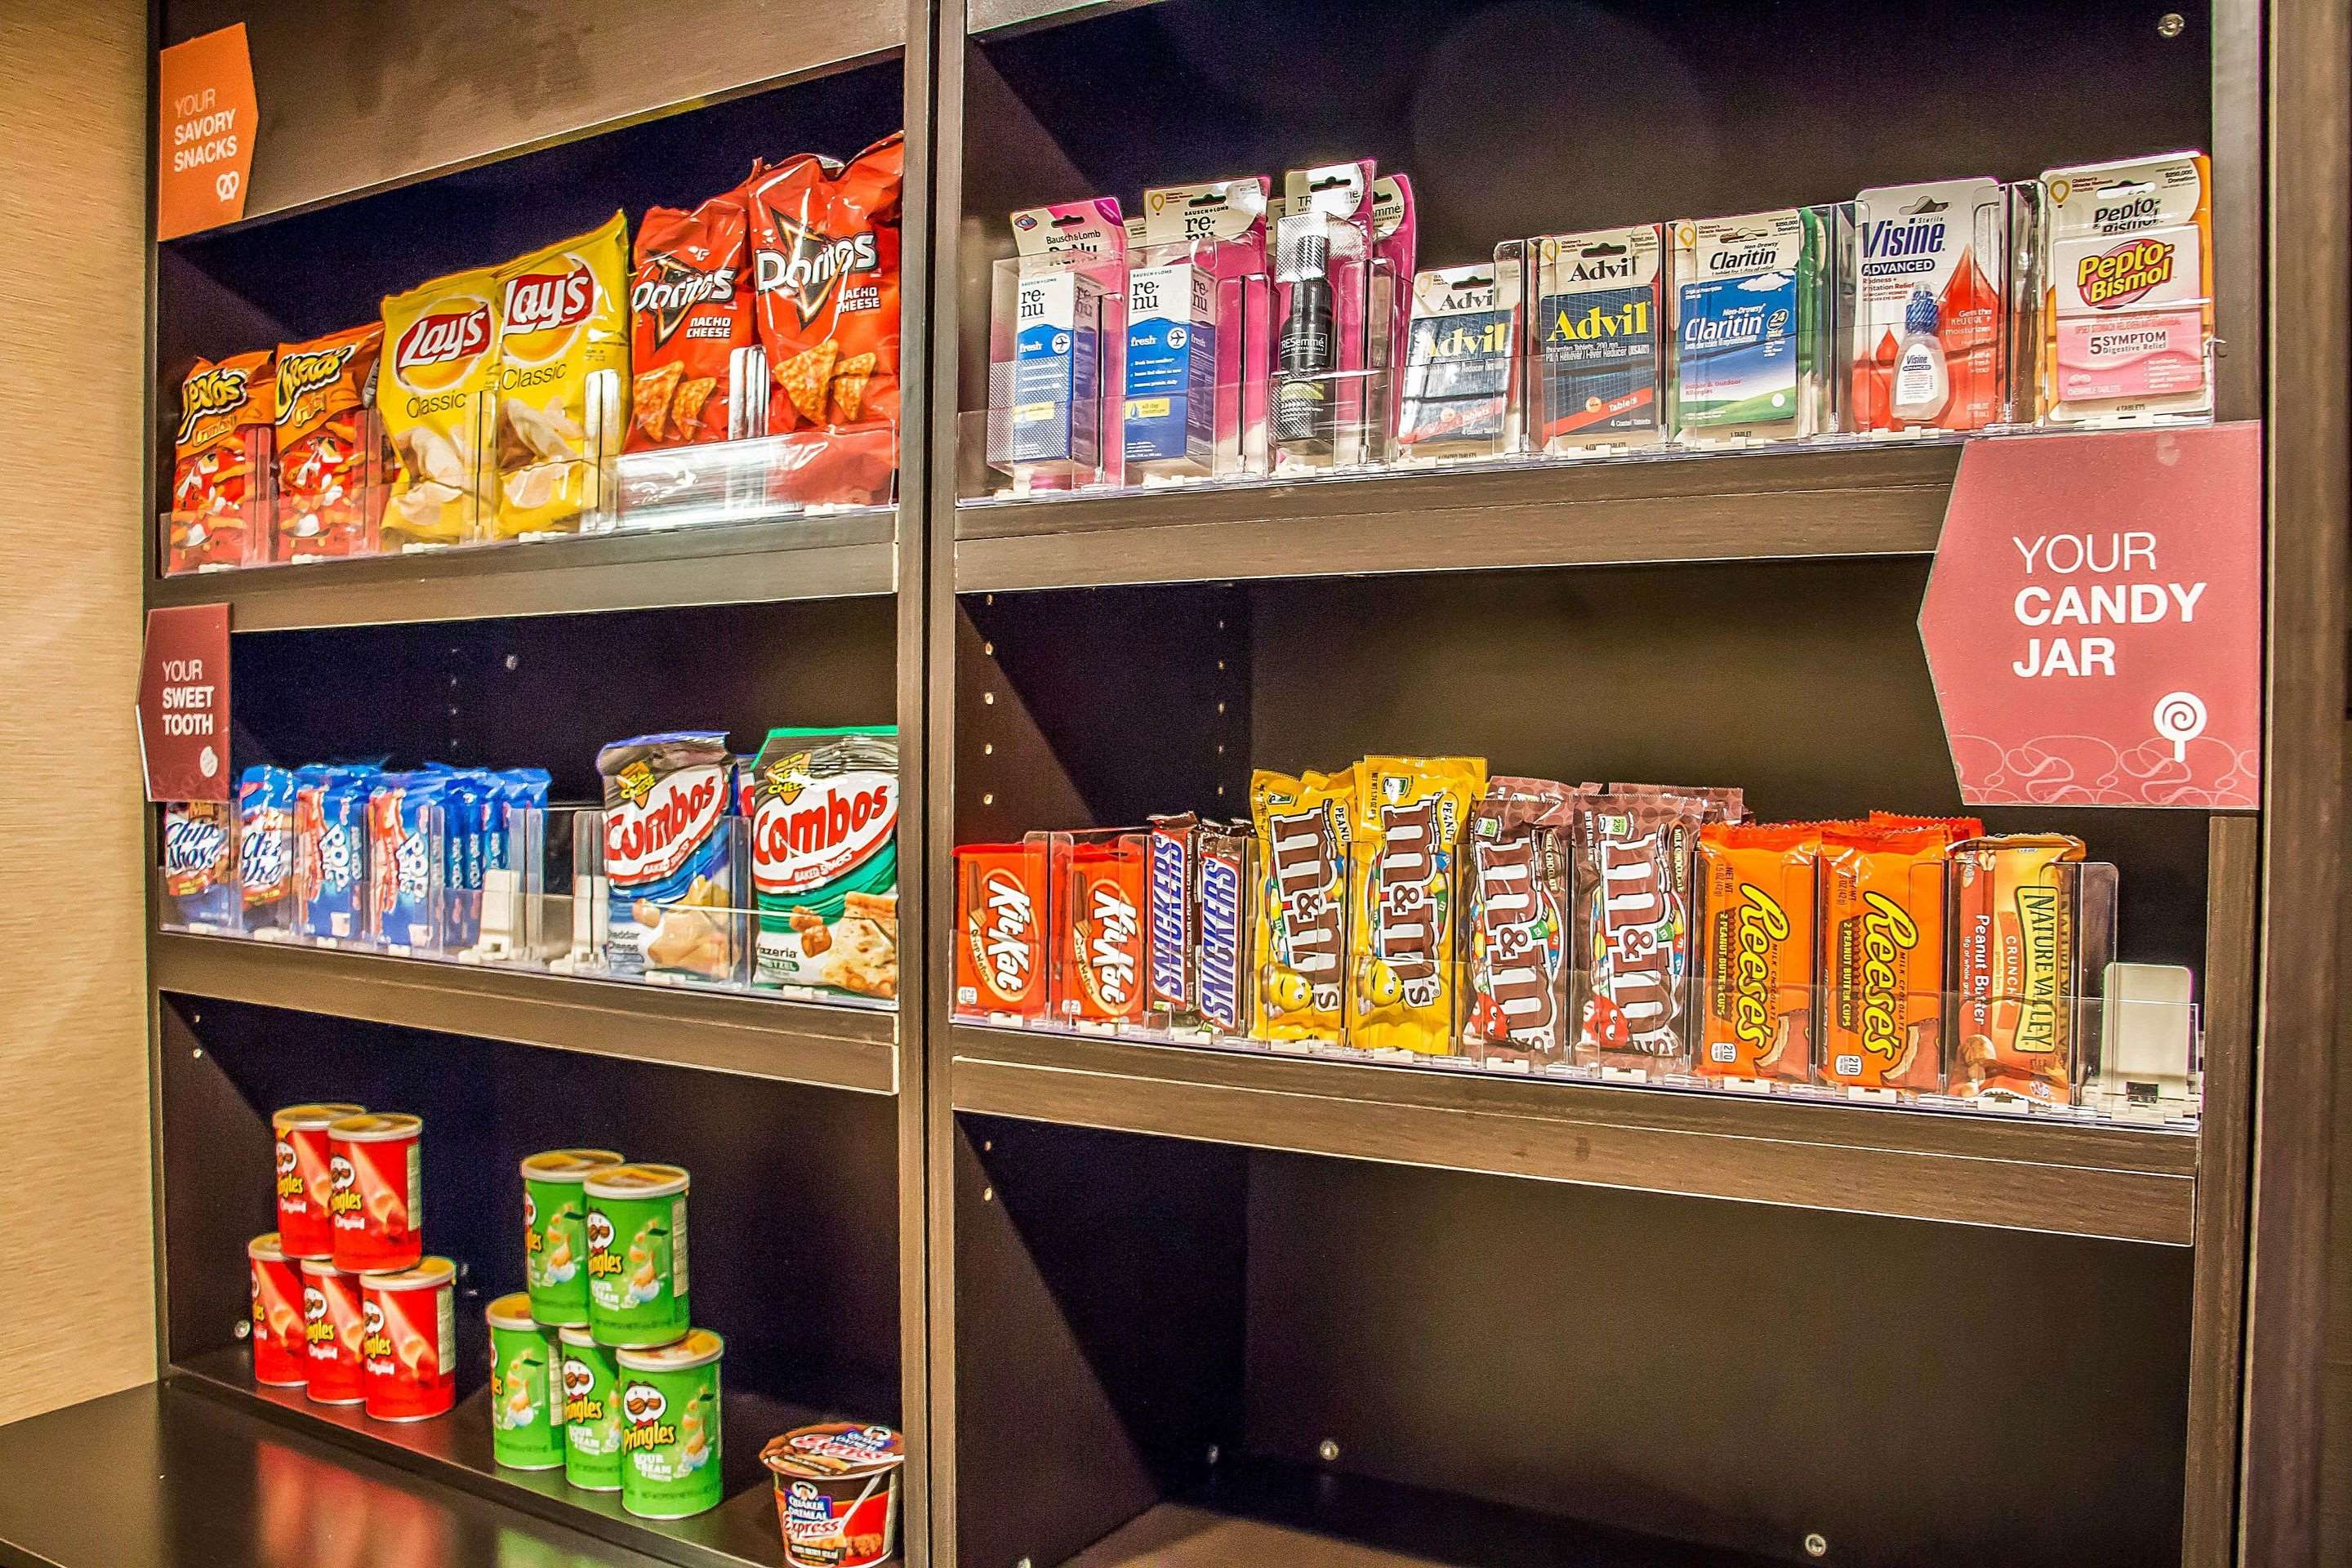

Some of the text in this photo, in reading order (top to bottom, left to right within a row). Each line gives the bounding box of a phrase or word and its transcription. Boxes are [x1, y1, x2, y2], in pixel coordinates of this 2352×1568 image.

[174, 87, 216, 118] YOUR
[174, 108, 236, 145] SAVORY
[174, 135, 238, 173] SNACKS
[1862, 218, 1945, 258] Visine
[755, 233, 877, 292] Doritos
[1568, 256, 1637, 282] Advil
[1710, 248, 1776, 270] Claritin
[1863, 261, 1933, 275] ADVANCED
[2078, 243, 2175, 285] Pepto-
[632, 270, 736, 314] Doritos
[2090, 259, 2170, 304] Bismol
[502, 272, 589, 336] Lay's
[1021, 302, 1045, 318] nu
[1133, 295, 1158, 310] nu
[1192, 294, 1208, 312] nu
[1722, 304, 1765, 317] Non-Drowsy
[1771, 312, 1785, 323] 24
[686, 327, 731, 337] CHEESE
[690, 317, 731, 327] NACHO
[1546, 301, 1648, 341] Advil
[1685, 314, 1762, 341] Claritin
[399, 310, 487, 368] Lay's
[1130, 336, 1157, 347] fresh
[2090, 331, 2167, 354] 5 SYMPTOM
[2103, 342, 2167, 354] Digestive Relief
[1907, 354, 1928, 365] Visine
[501, 362, 568, 390] Classic
[406, 390, 468, 418] Classic
[2122, 403, 2146, 412] TABLETS
[2012, 532, 2157, 573] YOUR
[2013, 582, 2207, 626] CANDY
[163, 659, 203, 682] YOUR
[2012, 638, 2116, 678] JAR
[163, 686, 215, 709] SWEET
[163, 713, 214, 736] TOOTH
[607, 776, 715, 860] Combos
[755, 786, 888, 865] Combos
[1334, 805, 1352, 846] PEANU
[1443, 802, 1454, 842] PEANUT
[1725, 867, 1734, 893] NET WT
[1152, 835, 1183, 999] SNICKERS
[757, 942, 797, 958] izzeria
[1202, 860, 1236, 1025] SNICKERS
[1717, 921, 1728, 956] PEANUT
[1842, 929, 1852, 964] PEANUT
[1963, 950, 1971, 958] of
[1717, 958, 1728, 991] BUTTER
[1735, 883, 1789, 1049] Reese's
[1862, 891, 1918, 1060] Reese's
[1974, 915, 1989, 1025] Peanut Butter
[2006, 936, 2018, 1007] CRUNCHY
[2021, 894, 2056, 1047] NATURE VALLEY
[1770, 970, 1778, 1021] CHOCOLATE
[1842, 968, 1852, 1001] BUTTER
[1717, 993, 1726, 1015] CUPS
[1842, 1004, 1851, 1027] CUPS
[1723, 1045, 1733, 1060] 210
[1848, 1058, 1859, 1073] 210
[624, 1421, 677, 1457] Pringles
[784, 1513, 840, 1539] Express
